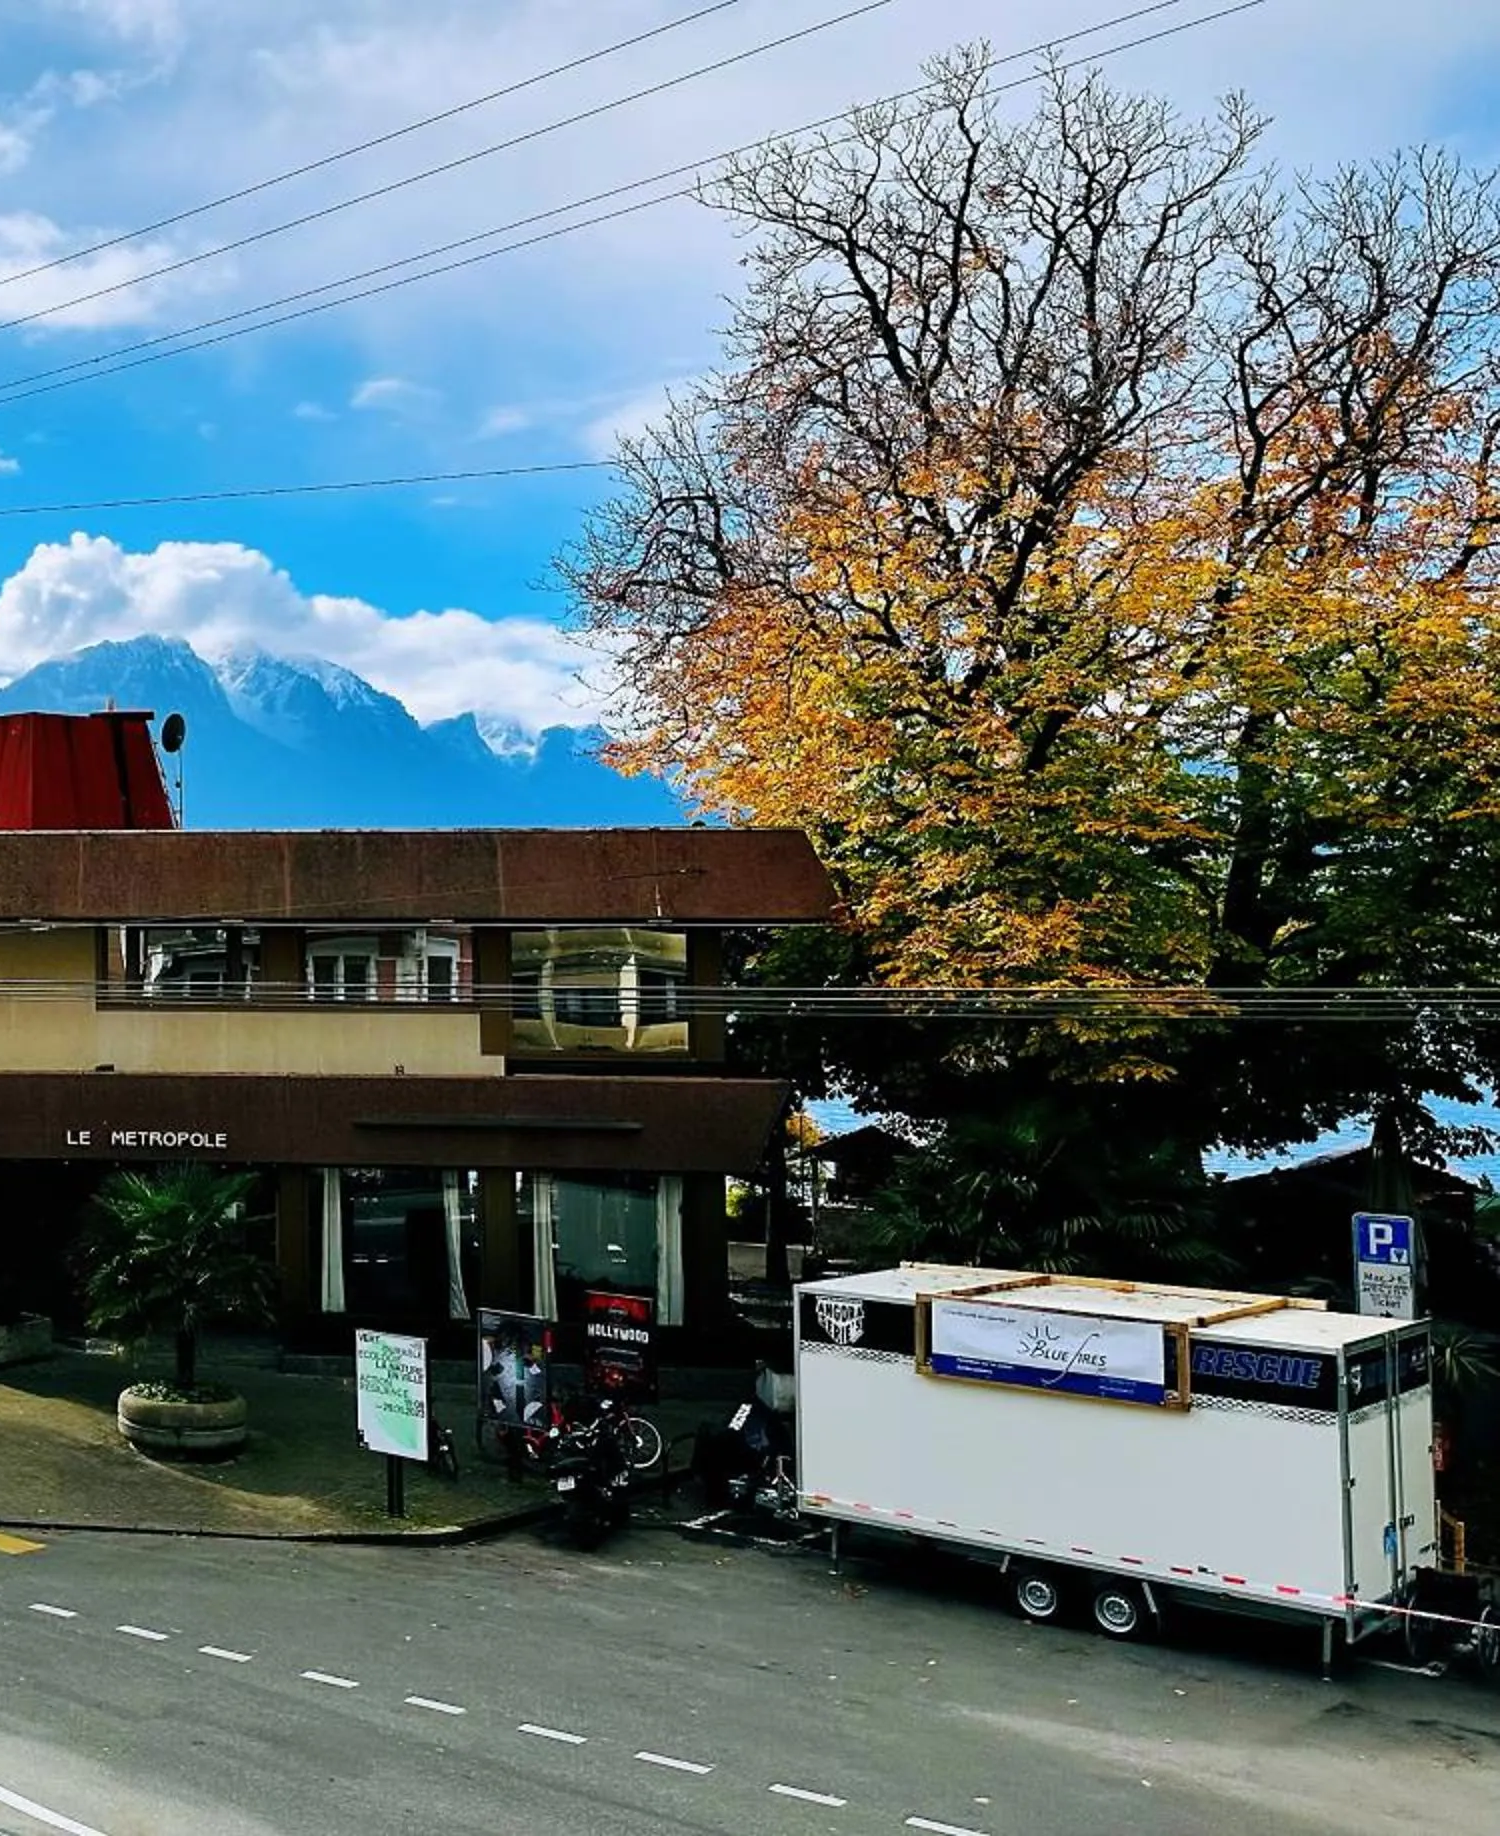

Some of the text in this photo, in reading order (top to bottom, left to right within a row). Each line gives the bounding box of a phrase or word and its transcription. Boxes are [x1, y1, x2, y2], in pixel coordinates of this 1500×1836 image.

[66, 1130, 228, 1148] LE METROPOLE
[1369, 1222, 1393, 1255] P
[587, 1323, 649, 1344] HOLLYWOOD
[1192, 1346, 1323, 1388] RESCUE
